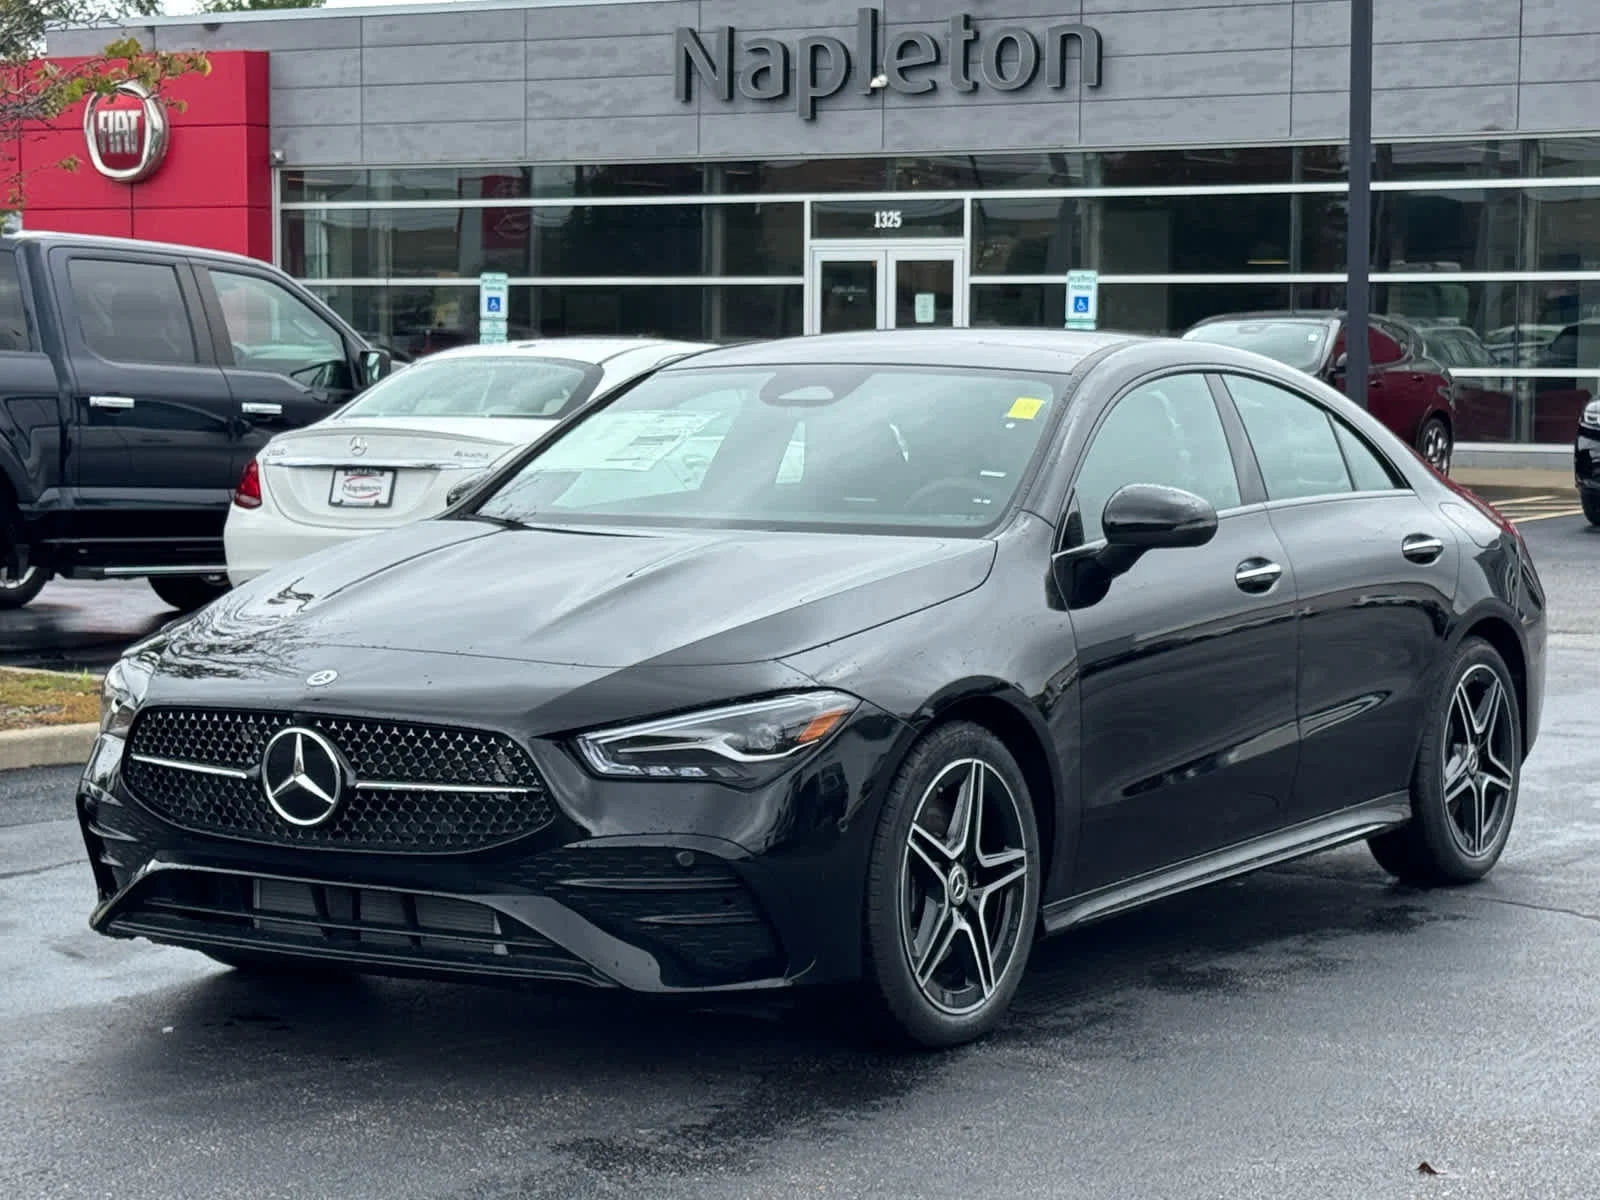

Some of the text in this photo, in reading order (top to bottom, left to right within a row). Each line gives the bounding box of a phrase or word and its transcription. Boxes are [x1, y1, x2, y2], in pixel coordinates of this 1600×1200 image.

[674, 7, 1102, 121] Napleton
[97, 109, 143, 154] FIAT
[874, 210, 903, 228] 1325
